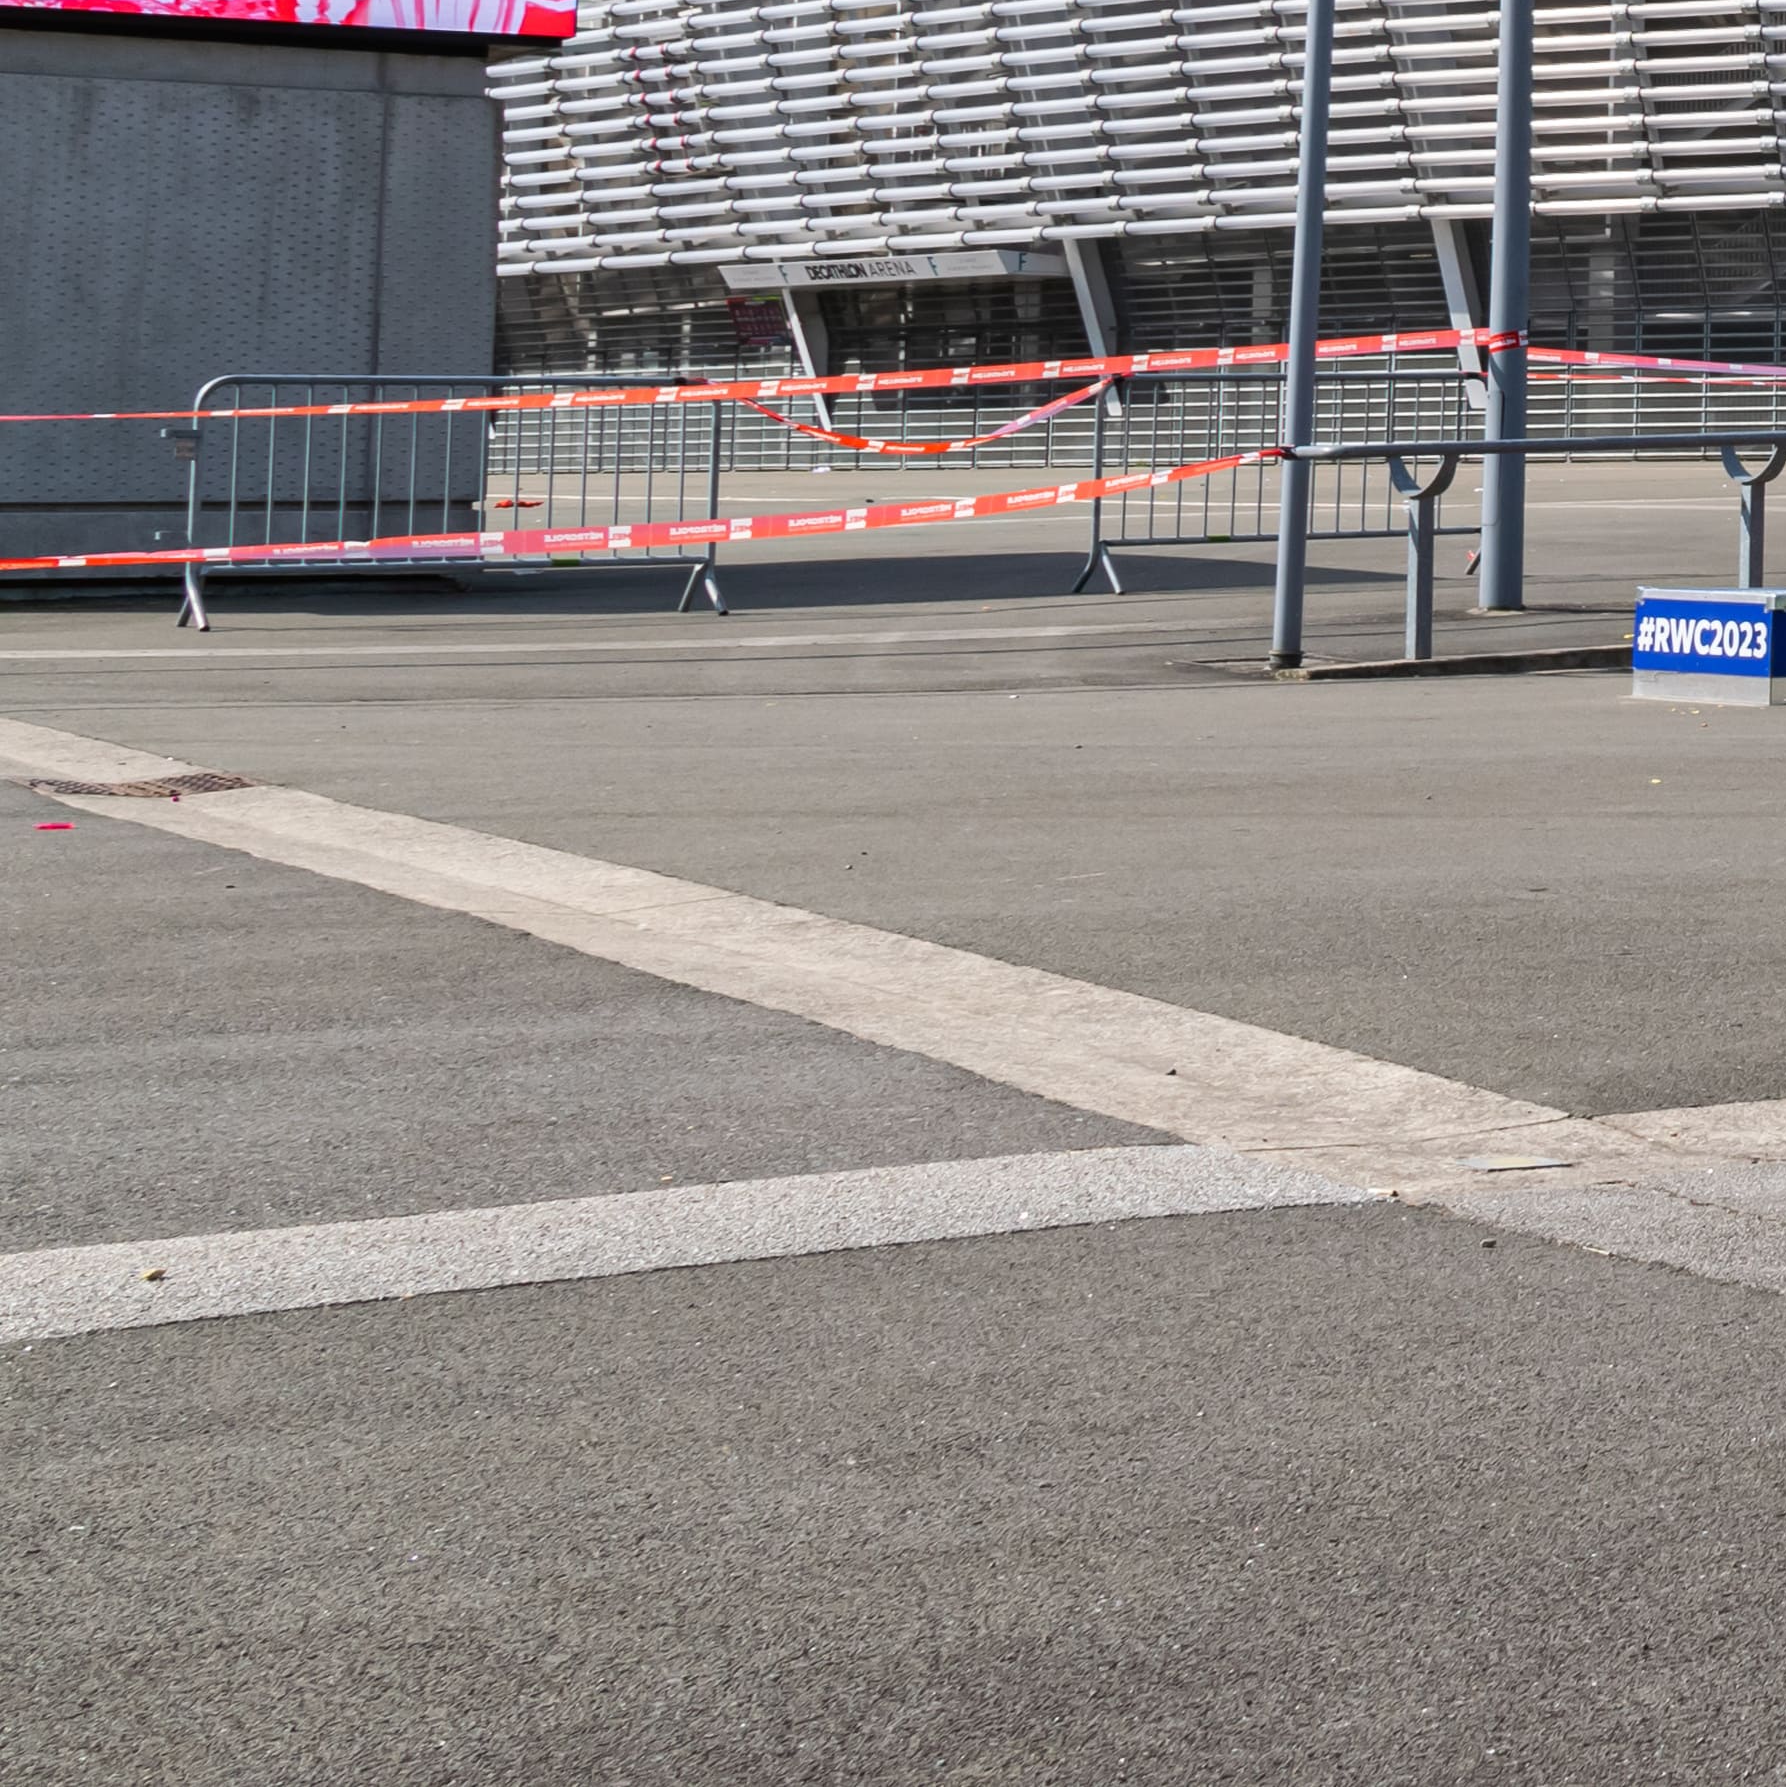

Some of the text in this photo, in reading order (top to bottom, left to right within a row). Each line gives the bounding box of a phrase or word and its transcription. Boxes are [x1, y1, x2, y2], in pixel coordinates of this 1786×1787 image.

[805, 261, 917, 280] DECATHLON ARENA
[1637, 616, 1768, 659] #RWC2023
